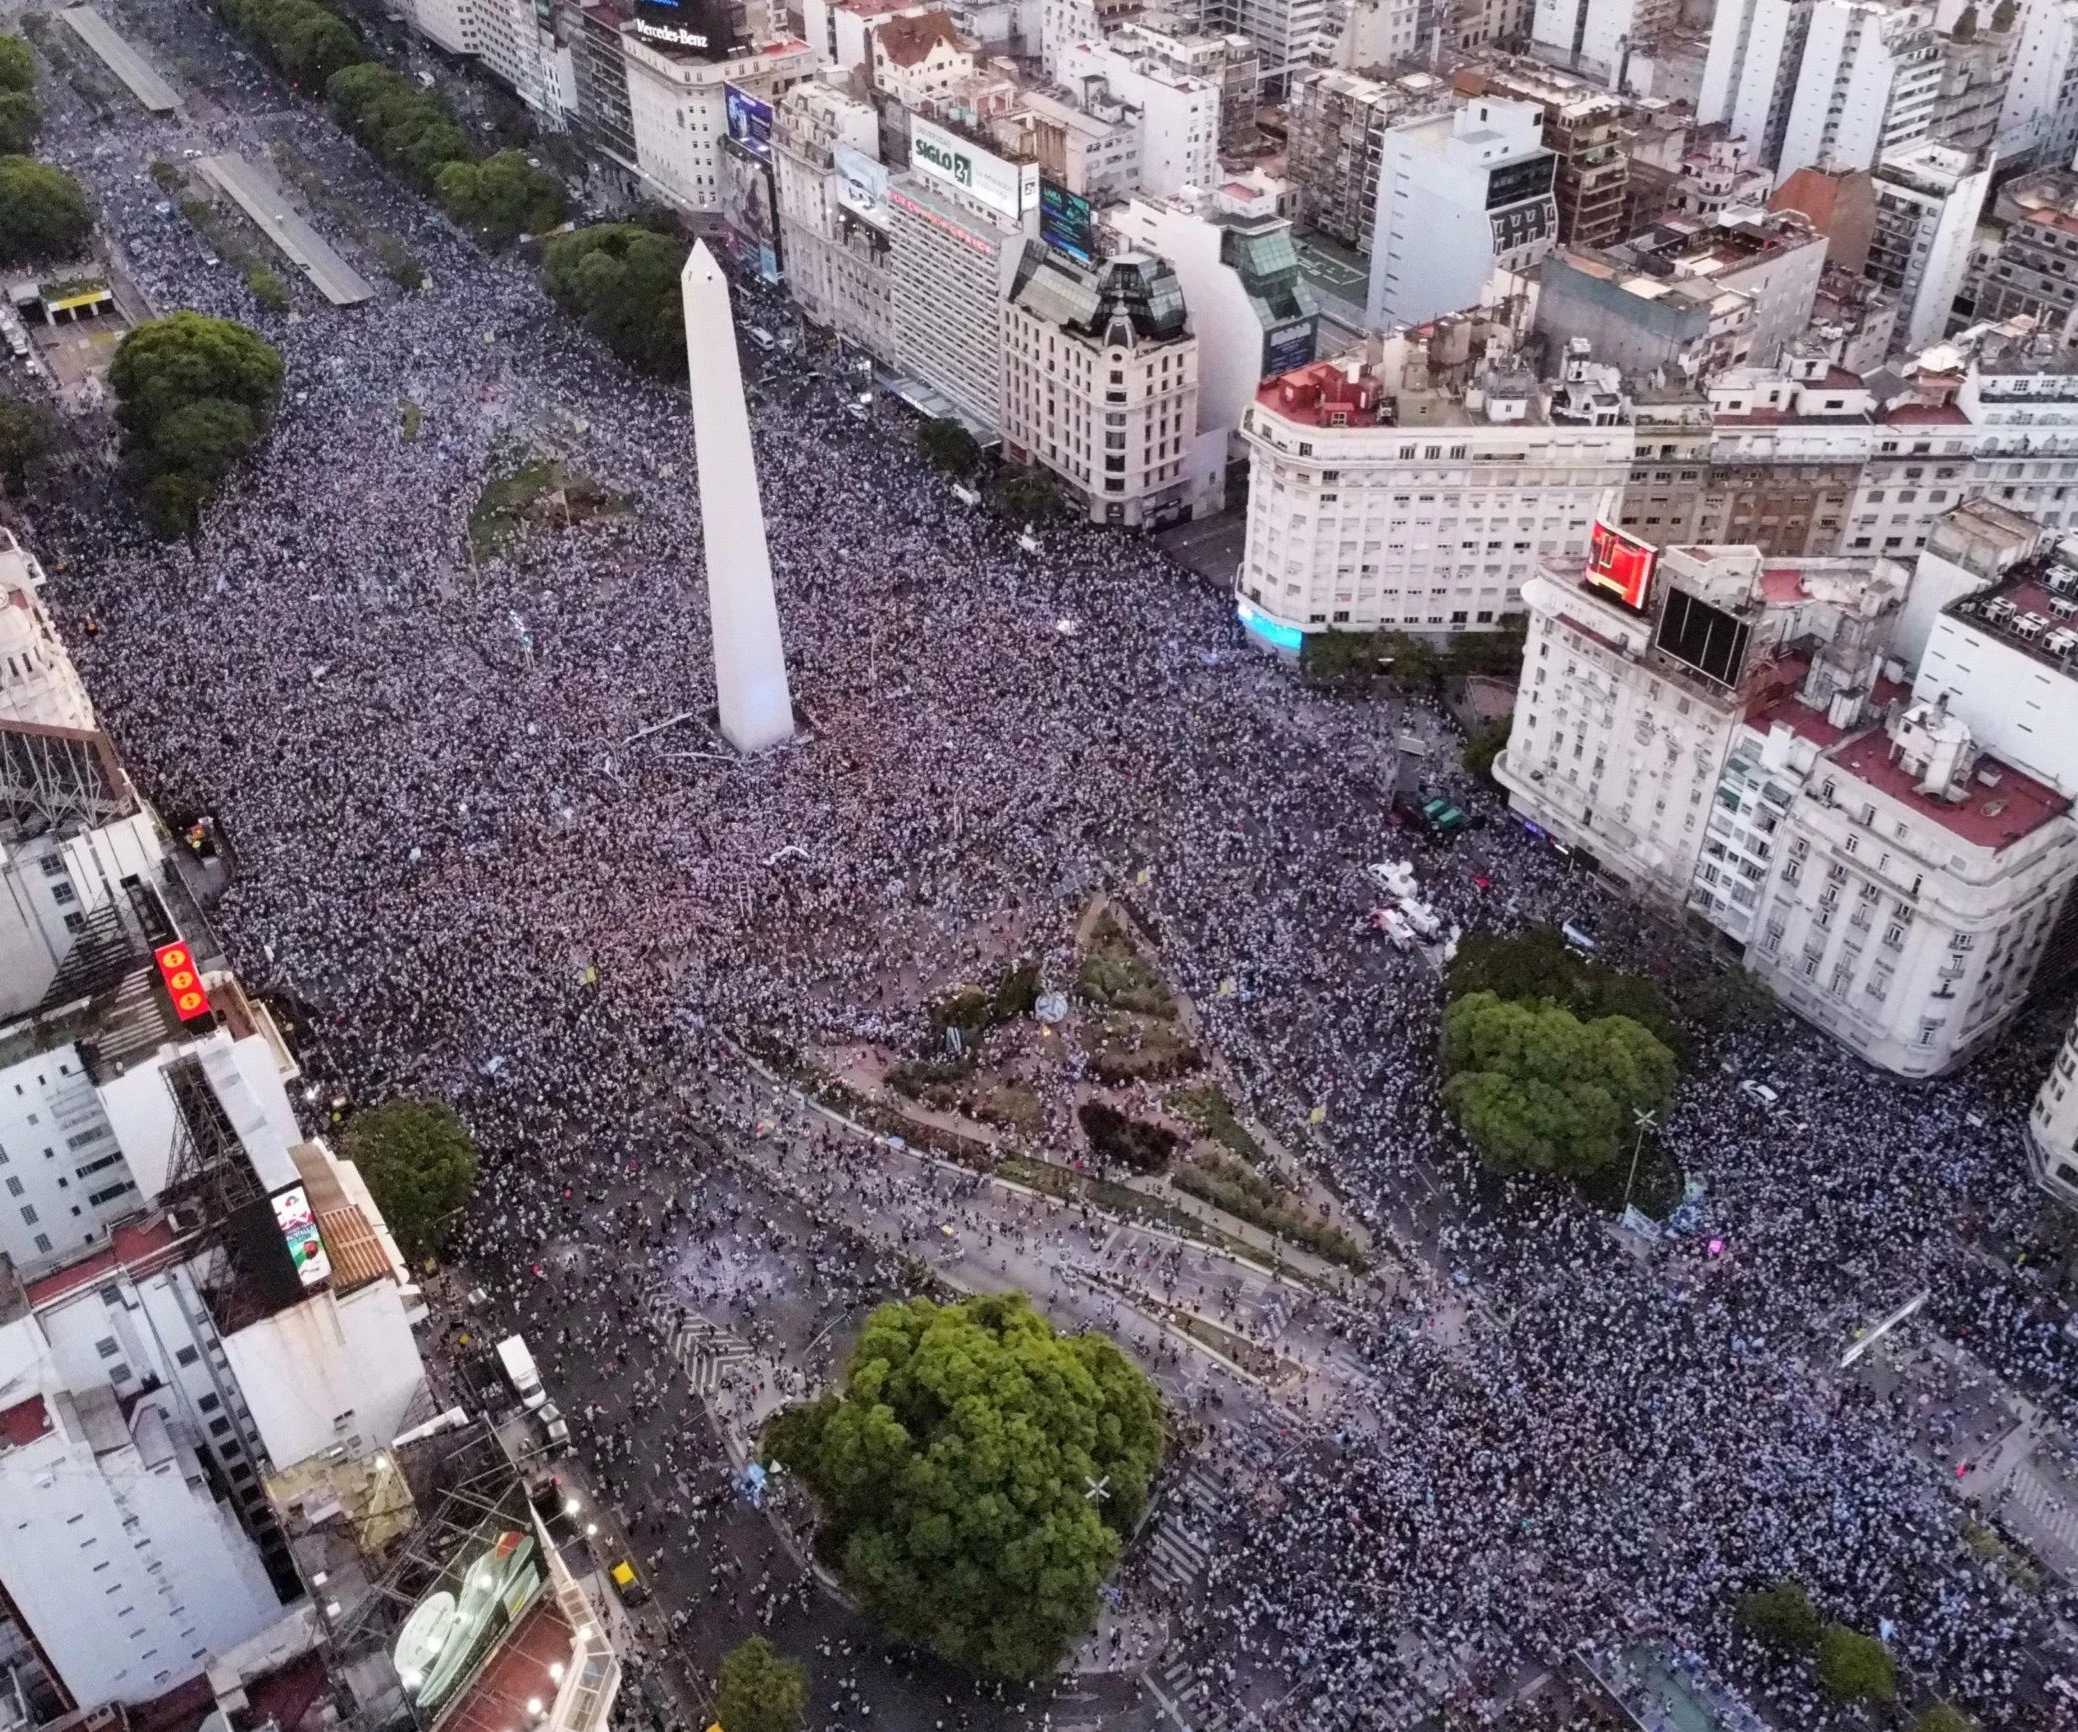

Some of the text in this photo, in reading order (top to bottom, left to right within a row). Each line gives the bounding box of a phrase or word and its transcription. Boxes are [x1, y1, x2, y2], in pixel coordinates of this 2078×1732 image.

[635, 18, 709, 48] Mercedes-Benz
[915, 138, 952, 171] SIGLO
[955, 157, 970, 185] 21
